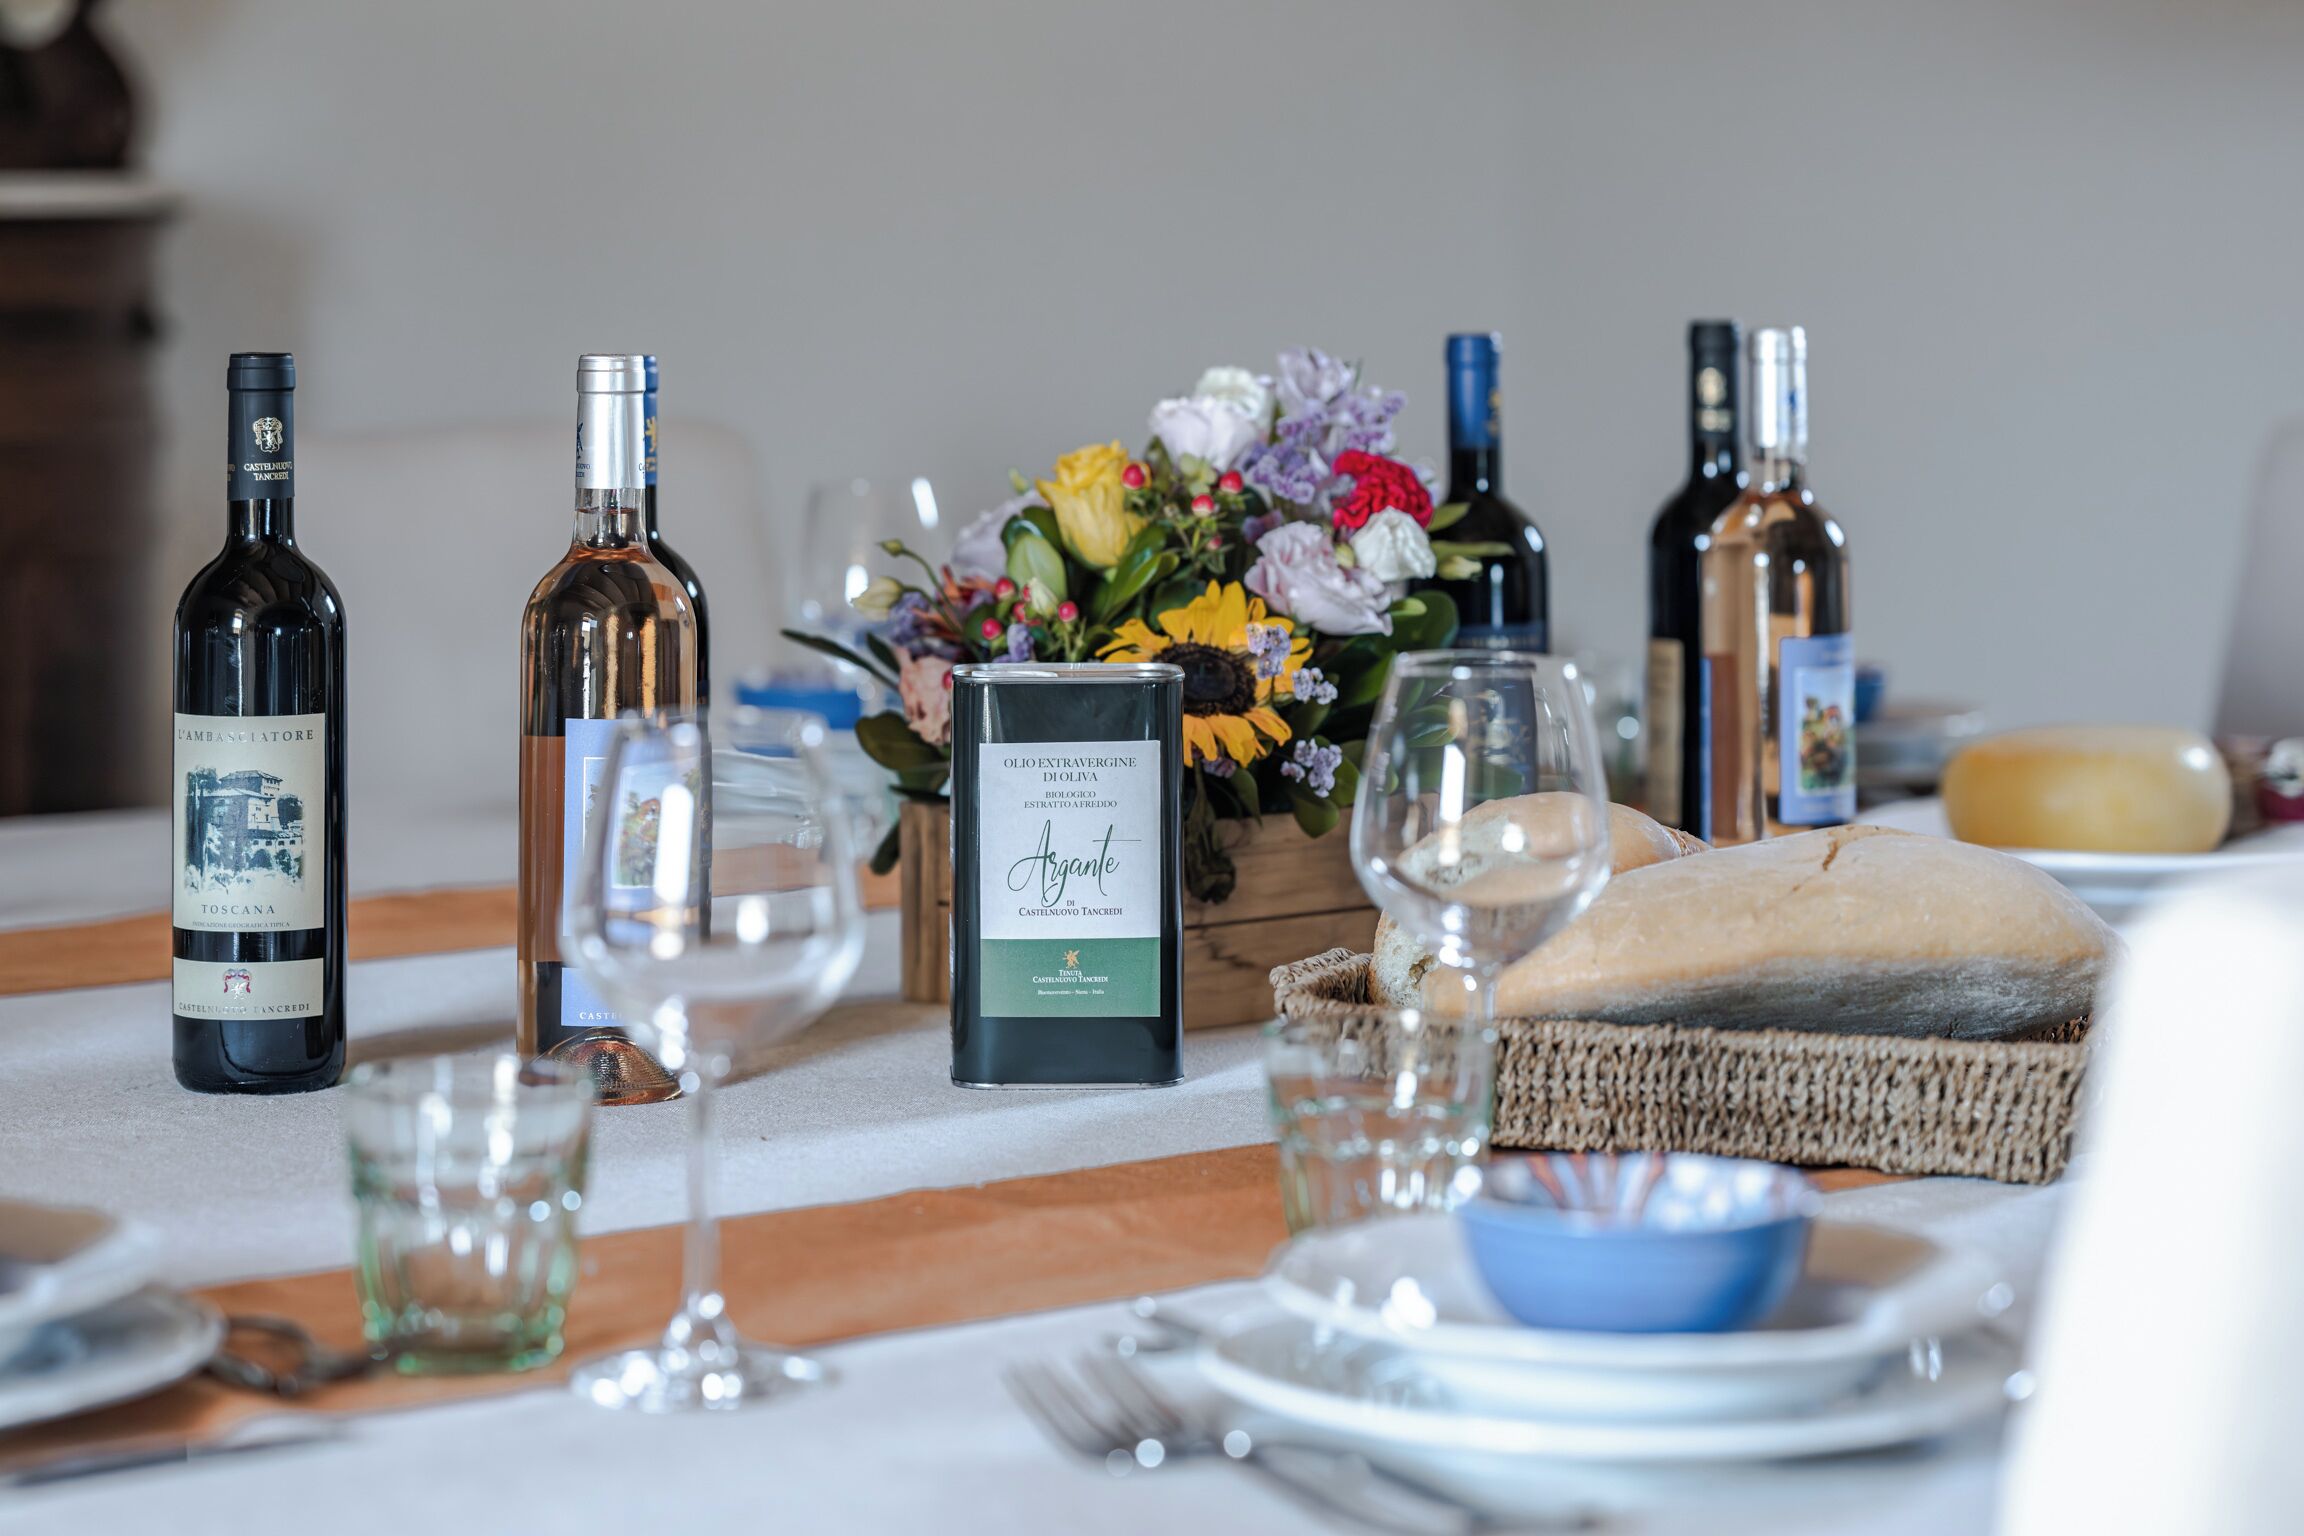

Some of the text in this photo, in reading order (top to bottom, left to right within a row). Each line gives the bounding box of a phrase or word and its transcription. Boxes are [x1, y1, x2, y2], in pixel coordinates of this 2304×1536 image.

[253, 472, 289, 481] TANCREDI
[1004, 757, 1137, 769] OLIO EXTRAVERGINE
[1043, 771, 1098, 782] DI OLIVA
[1045, 791, 1096, 799] BIOLOGICO
[1024, 800, 1118, 809] ESTRATTO A FREDDO
[1008, 819, 1142, 908] Argante
[201, 904, 275, 915] TOSCANA
[1018, 906, 1123, 917] CASTELNUOVO TANCREDI
[253, 1003, 310, 1013] TANCREDI
